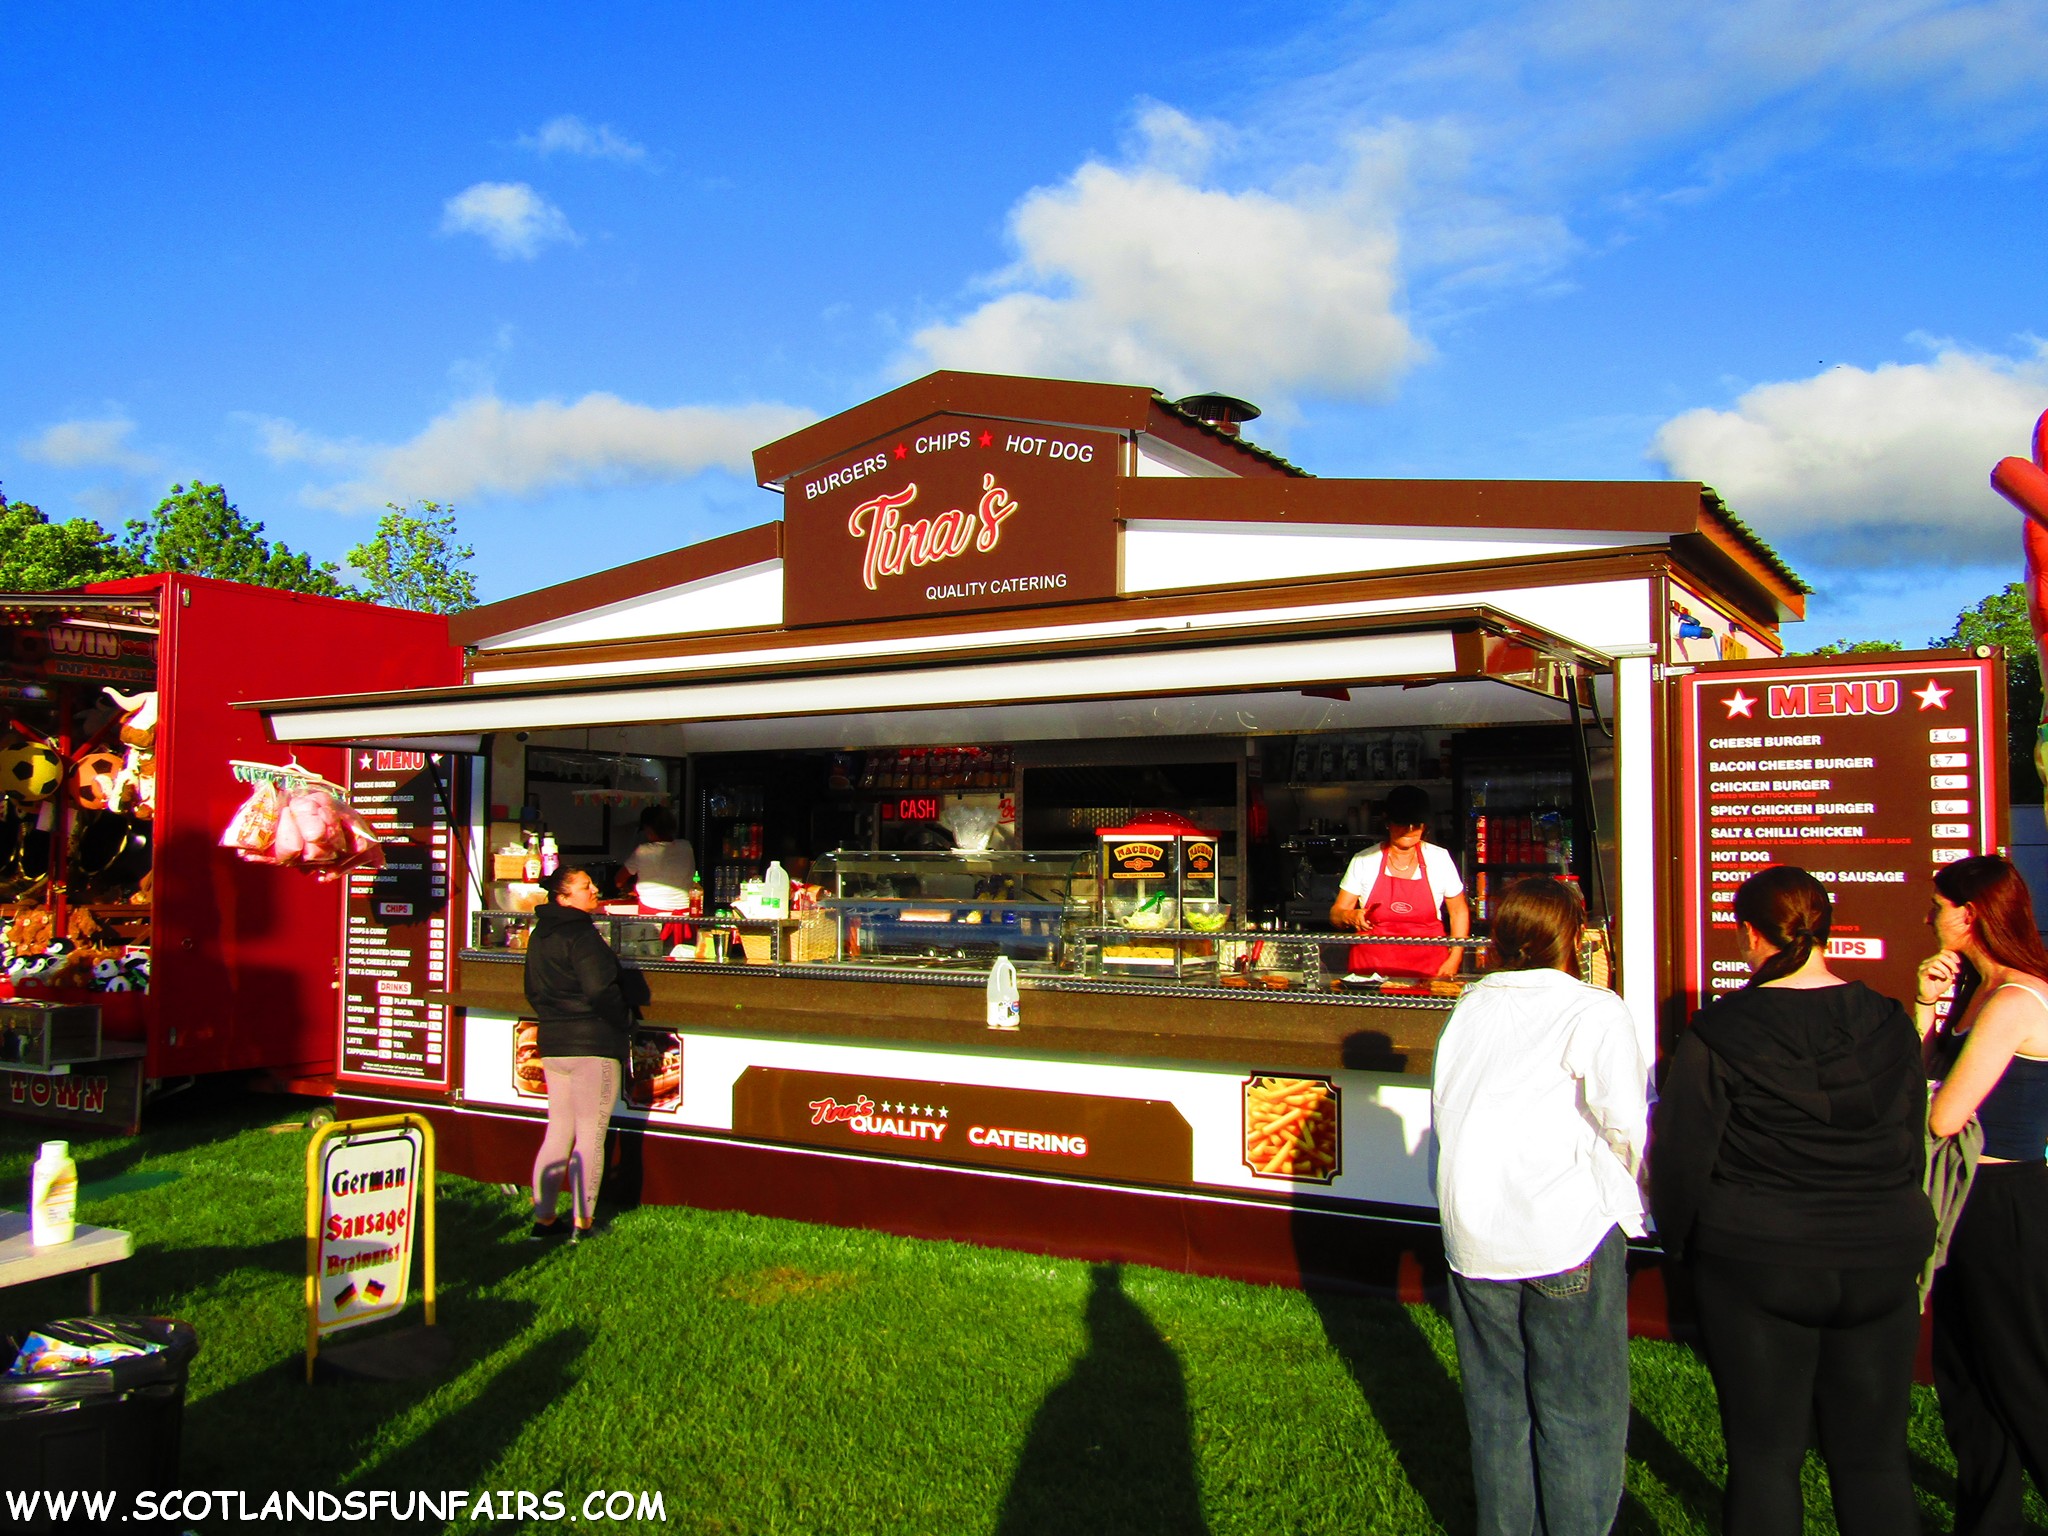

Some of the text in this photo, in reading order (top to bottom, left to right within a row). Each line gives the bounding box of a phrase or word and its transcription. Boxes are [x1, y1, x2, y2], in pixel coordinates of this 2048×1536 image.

[805, 430, 1094, 500] BURGERS CHIPS HOT DOG
[848, 472, 1018, 591] Tina's
[926, 574, 1067, 601] QUALITY CATERING
[50, 626, 119, 656] WIN
[1768, 680, 1898, 718] MENU
[1710, 735, 1821, 749] CHEESE BURGER
[377, 750, 424, 771] MENU
[1710, 758, 1873, 772] BACON CHEESE BURGER
[1710, 780, 1830, 792] CHICKEN BURGER
[900, 799, 935, 819] CASH
[1711, 803, 1874, 816] SPICY CHICKEN BURGER
[1711, 826, 1863, 838] SALT & CHILLI CHICKEN
[1117, 846, 1161, 858] NACHOS
[1711, 852, 1770, 862] HOT DOG
[1838, 872, 1904, 882] SAUSAGE
[386, 904, 408, 913] CHIPS
[1828, 942, 1866, 955] HIPS
[381, 982, 408, 992] DRINKS
[10, 1072, 108, 1113] TOWN
[809, 1095, 875, 1125] Tina's
[850, 1116, 1087, 1156] QUALITY CATERING
[332, 1166, 406, 1197] German
[325, 1208, 406, 1241] Sausage
